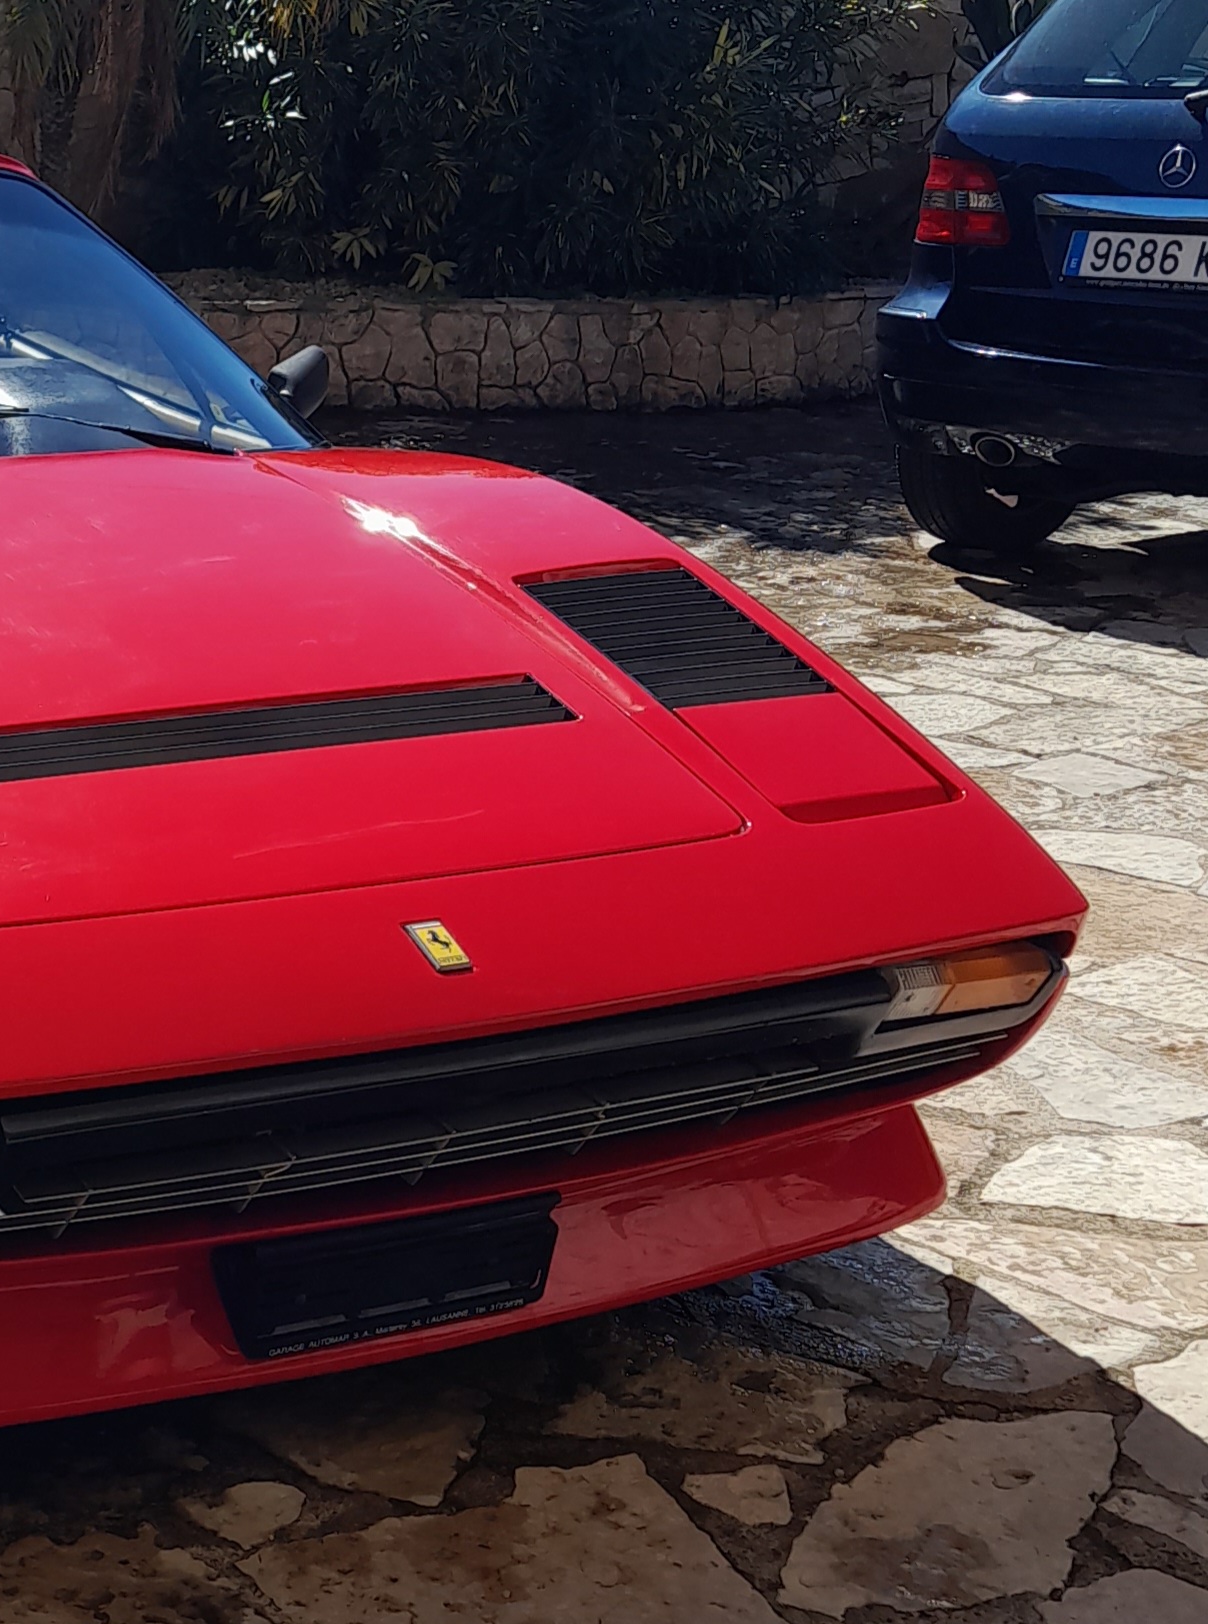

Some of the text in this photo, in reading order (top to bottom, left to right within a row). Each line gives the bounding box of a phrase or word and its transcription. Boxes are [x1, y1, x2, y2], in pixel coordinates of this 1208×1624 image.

[1070, 258, 1078, 268] E
[1090, 237, 1183, 275] 9686
[268, 1343, 305, 1357] GARAGE
